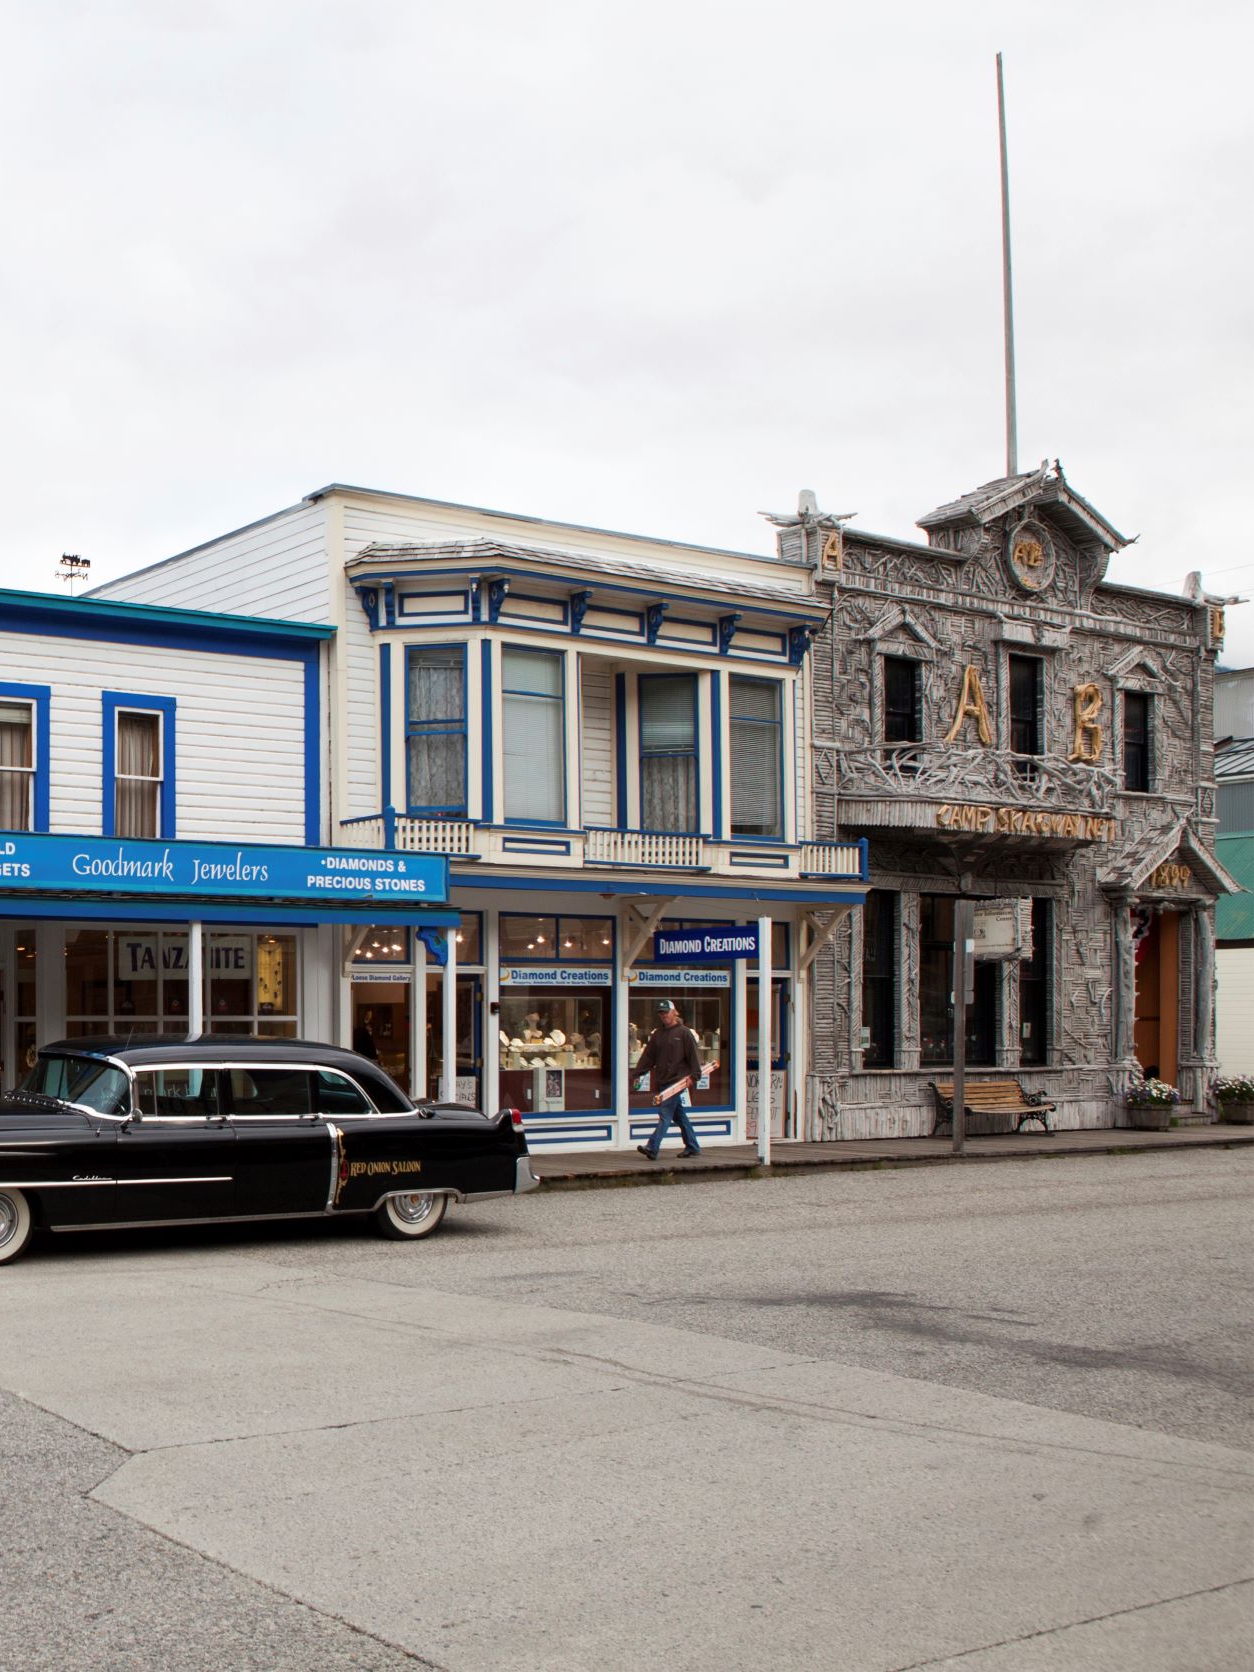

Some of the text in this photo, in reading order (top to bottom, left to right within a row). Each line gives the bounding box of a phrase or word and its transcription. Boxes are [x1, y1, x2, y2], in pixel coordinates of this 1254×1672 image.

[945, 664, 992, 746] A
[936, 804, 993, 831] CAMP
[72, 846, 269, 885] Goodmark Jewelers
[326, 856, 407, 873] DIAMONDS &
[307, 875, 426, 892] PRECIOUS STONES
[1149, 863, 1191, 888] 1899
[659, 935, 756, 955] DIAMOND CREATIONS
[126, 942, 246, 972] TANZITE
[511, 969, 609, 981] Diamond Creations
[638, 971, 728, 983] Diamond Creations
[350, 1160, 421, 1176] RED ONION SALOON
